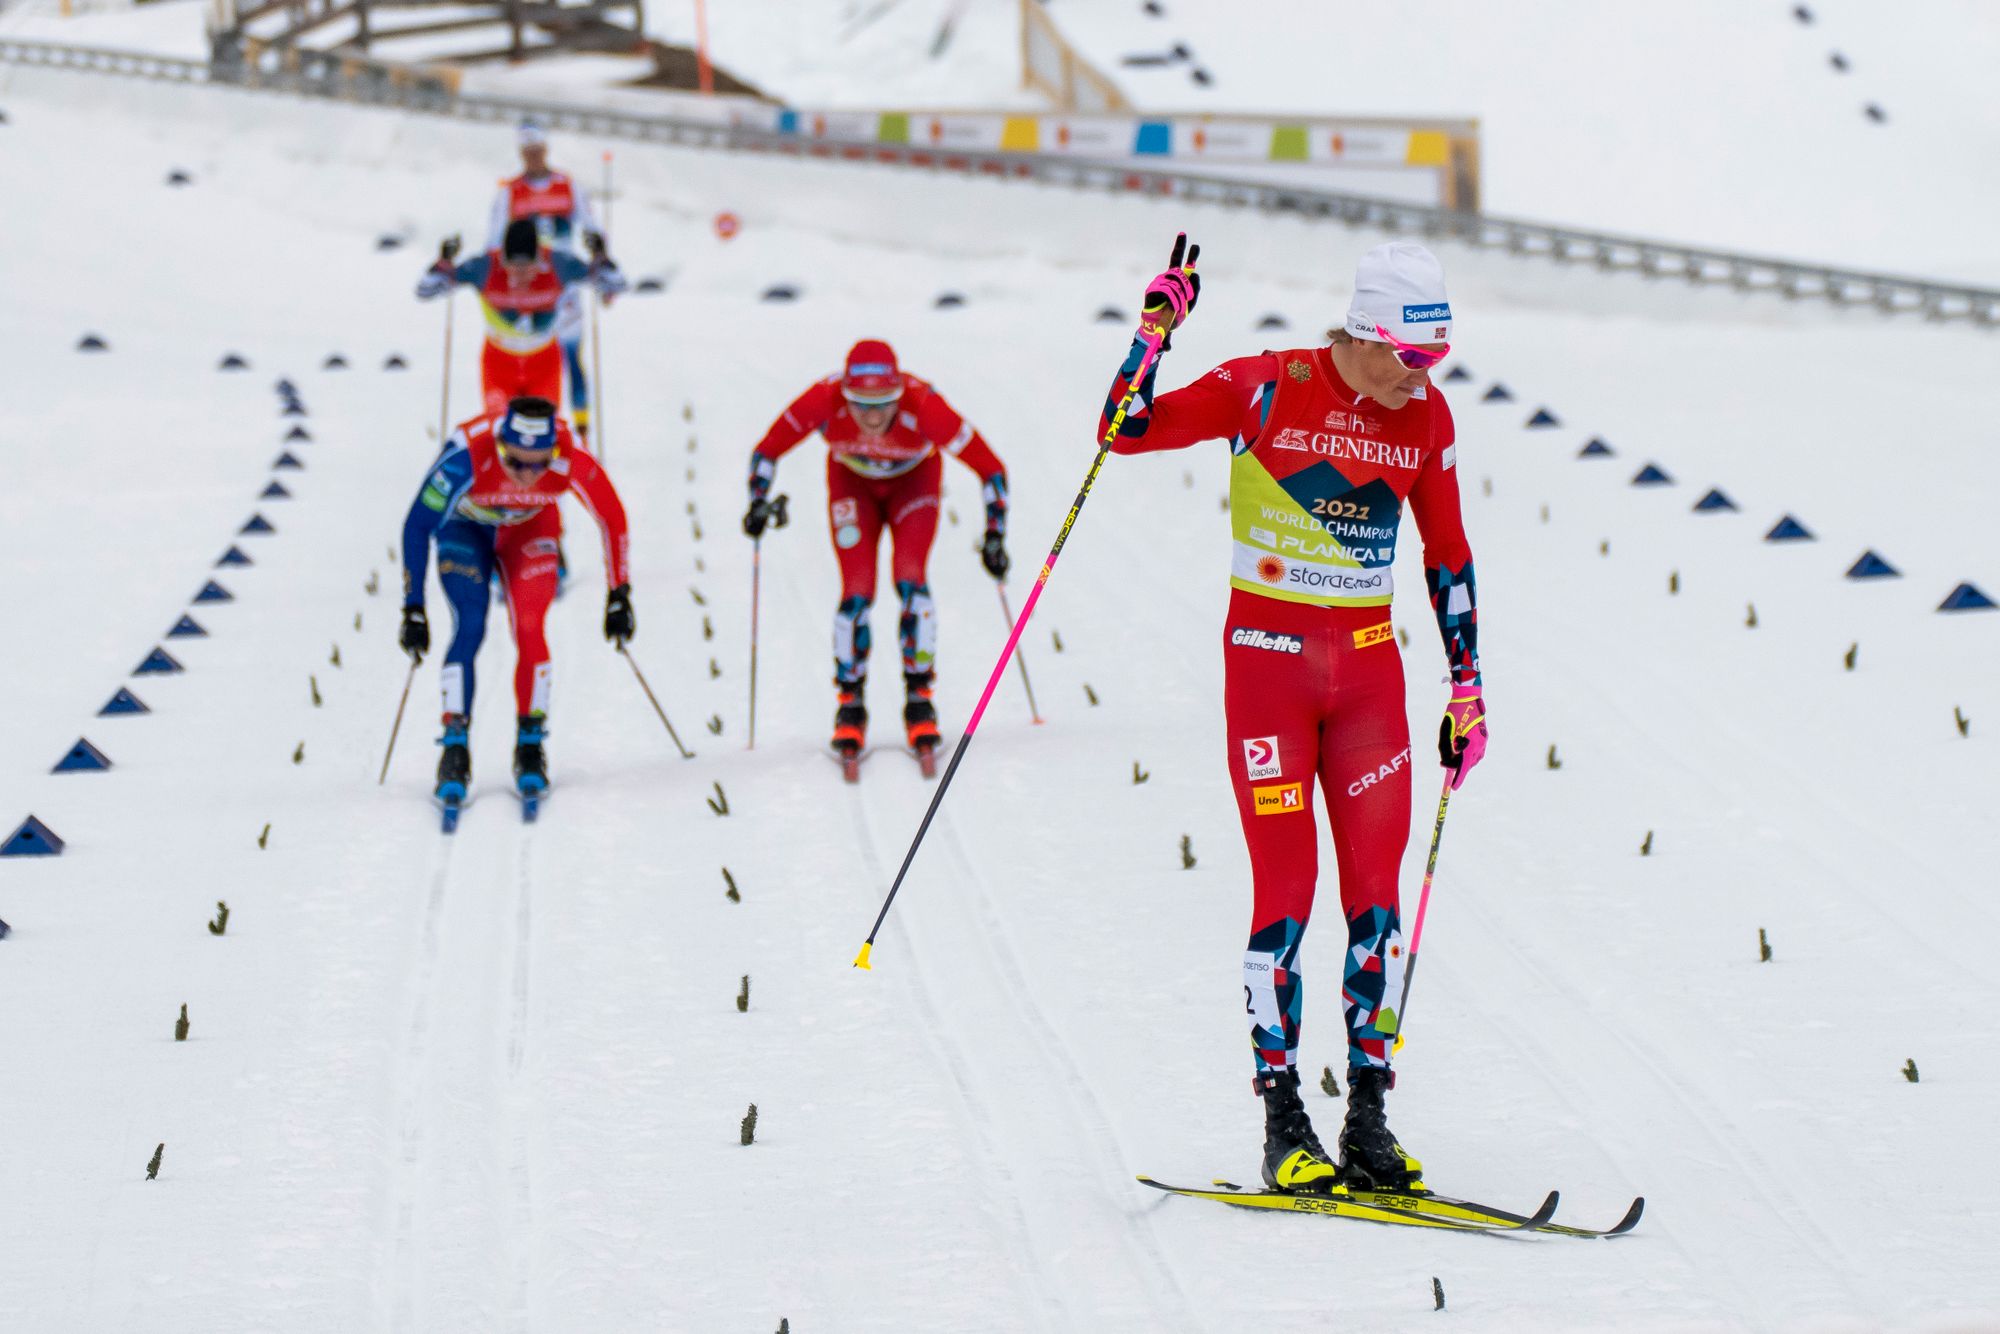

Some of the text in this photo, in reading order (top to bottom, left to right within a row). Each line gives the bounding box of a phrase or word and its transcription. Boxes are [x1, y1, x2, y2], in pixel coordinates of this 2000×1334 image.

[1104, 395, 1133, 443] LEKI
[1311, 432, 1421, 470] GENERALI
[1260, 504, 1323, 532] WORLD
[1311, 498, 1371, 521] 2021
[1281, 535, 1377, 562] PLANICA
[1231, 628, 1302, 654] Gillette
[1364, 624, 1392, 643] DH
[1249, 767, 1280, 778] viaplay
[1347, 748, 1409, 797] CRAFT
[1258, 789, 1297, 807] Uno X
[1244, 984, 1256, 1015] 2
[1294, 1198, 1338, 1213] FISCHER
[1373, 1194, 1419, 1210] FISCHER
